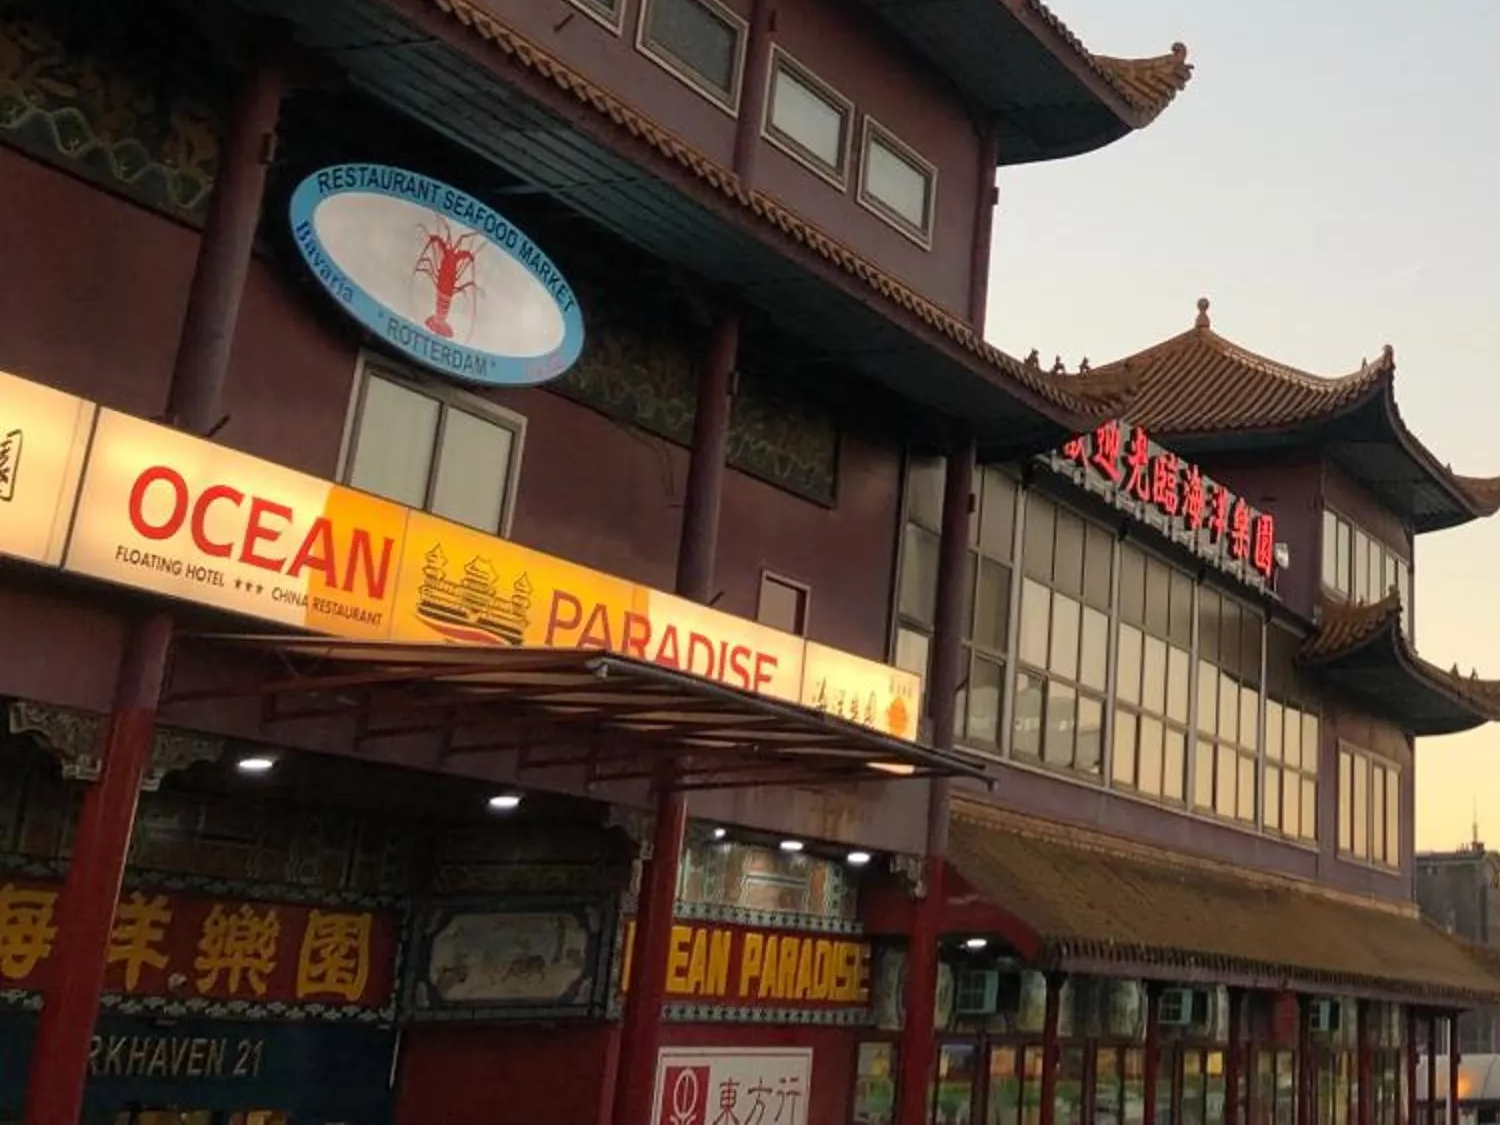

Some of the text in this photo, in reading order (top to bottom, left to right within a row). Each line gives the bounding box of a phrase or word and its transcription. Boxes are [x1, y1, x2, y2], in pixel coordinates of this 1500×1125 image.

[296, 218, 354, 303] Bavaria
[317, 166, 575, 312] RESTAURANT SEAFOOD MARKET
[387, 317, 487, 376] ROTTERDAM
[129, 465, 395, 600] OCEAN
[115, 545, 383, 626] FLOATING HOTEL CHINA RESTAURANT
[544, 587, 778, 693] PARADISE
[739, 931, 872, 1002] PARADISE
[233, 1038, 264, 1077] 21
